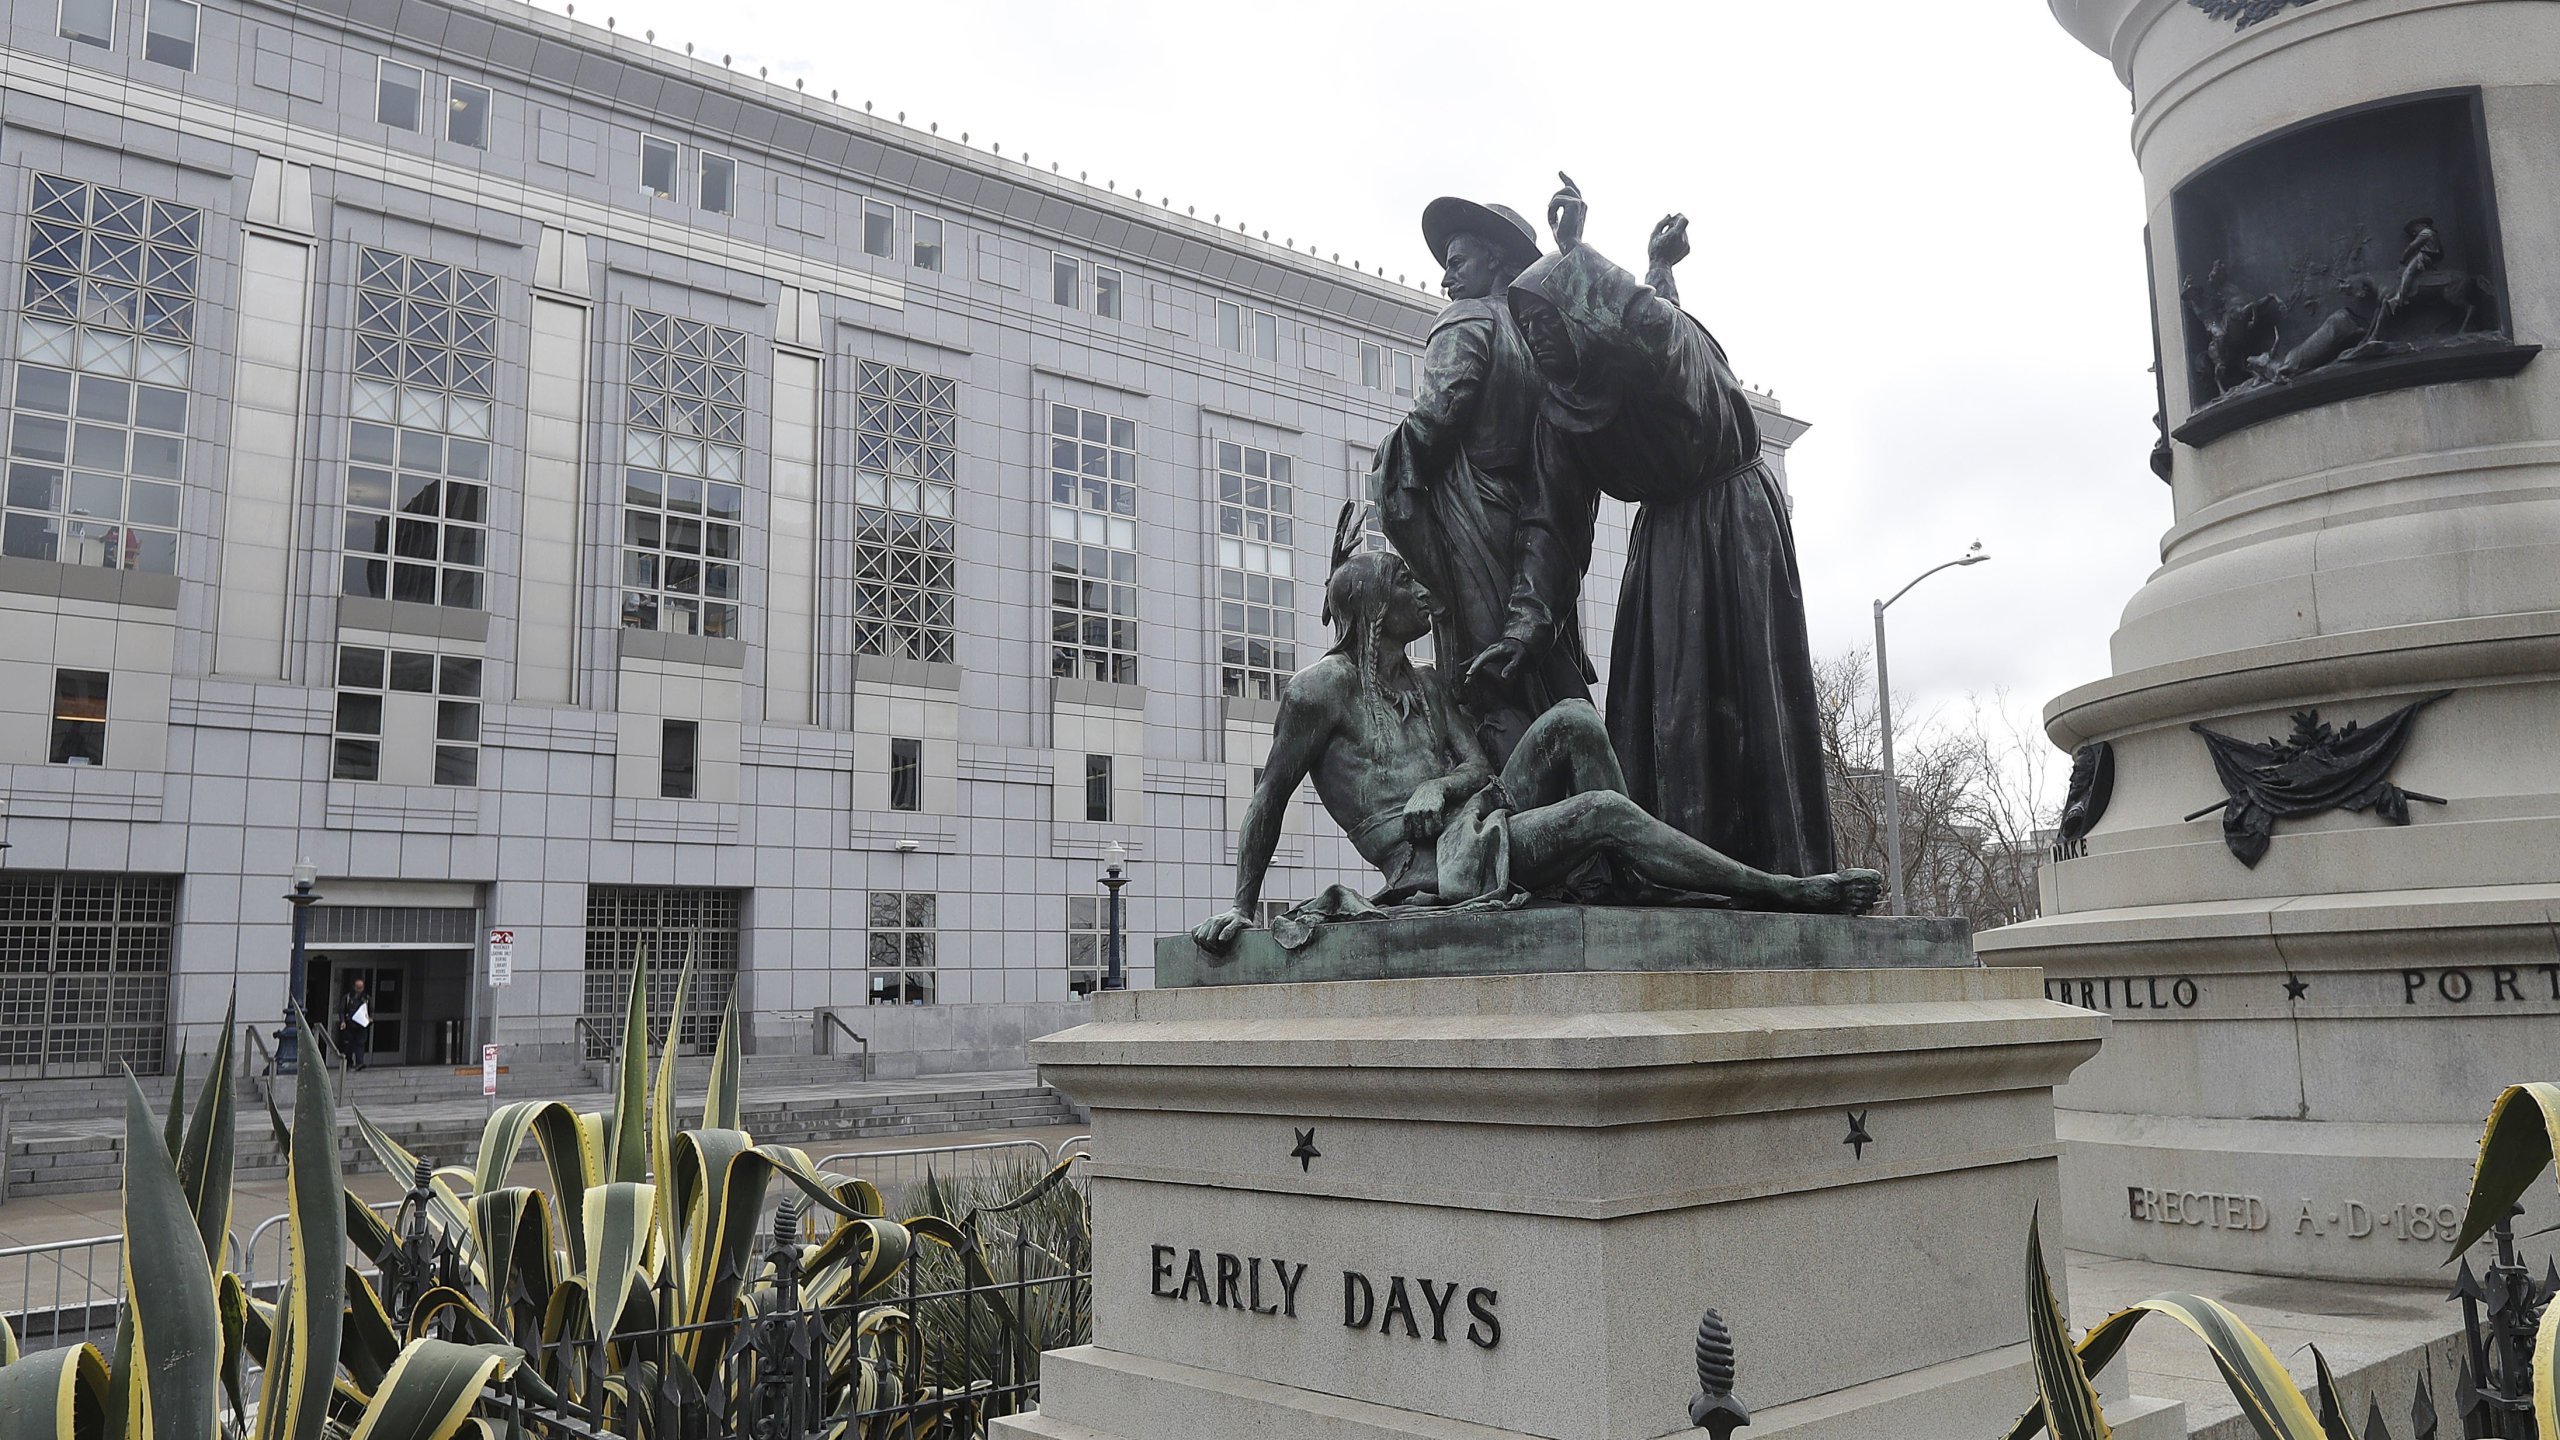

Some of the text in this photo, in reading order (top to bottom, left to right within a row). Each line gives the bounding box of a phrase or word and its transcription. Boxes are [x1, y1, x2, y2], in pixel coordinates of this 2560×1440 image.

[2402, 964, 2560, 1004] PORT
[2127, 1186, 2270, 1231] ERECTED
[1150, 1244, 1501, 1350] EARLY DAYS
